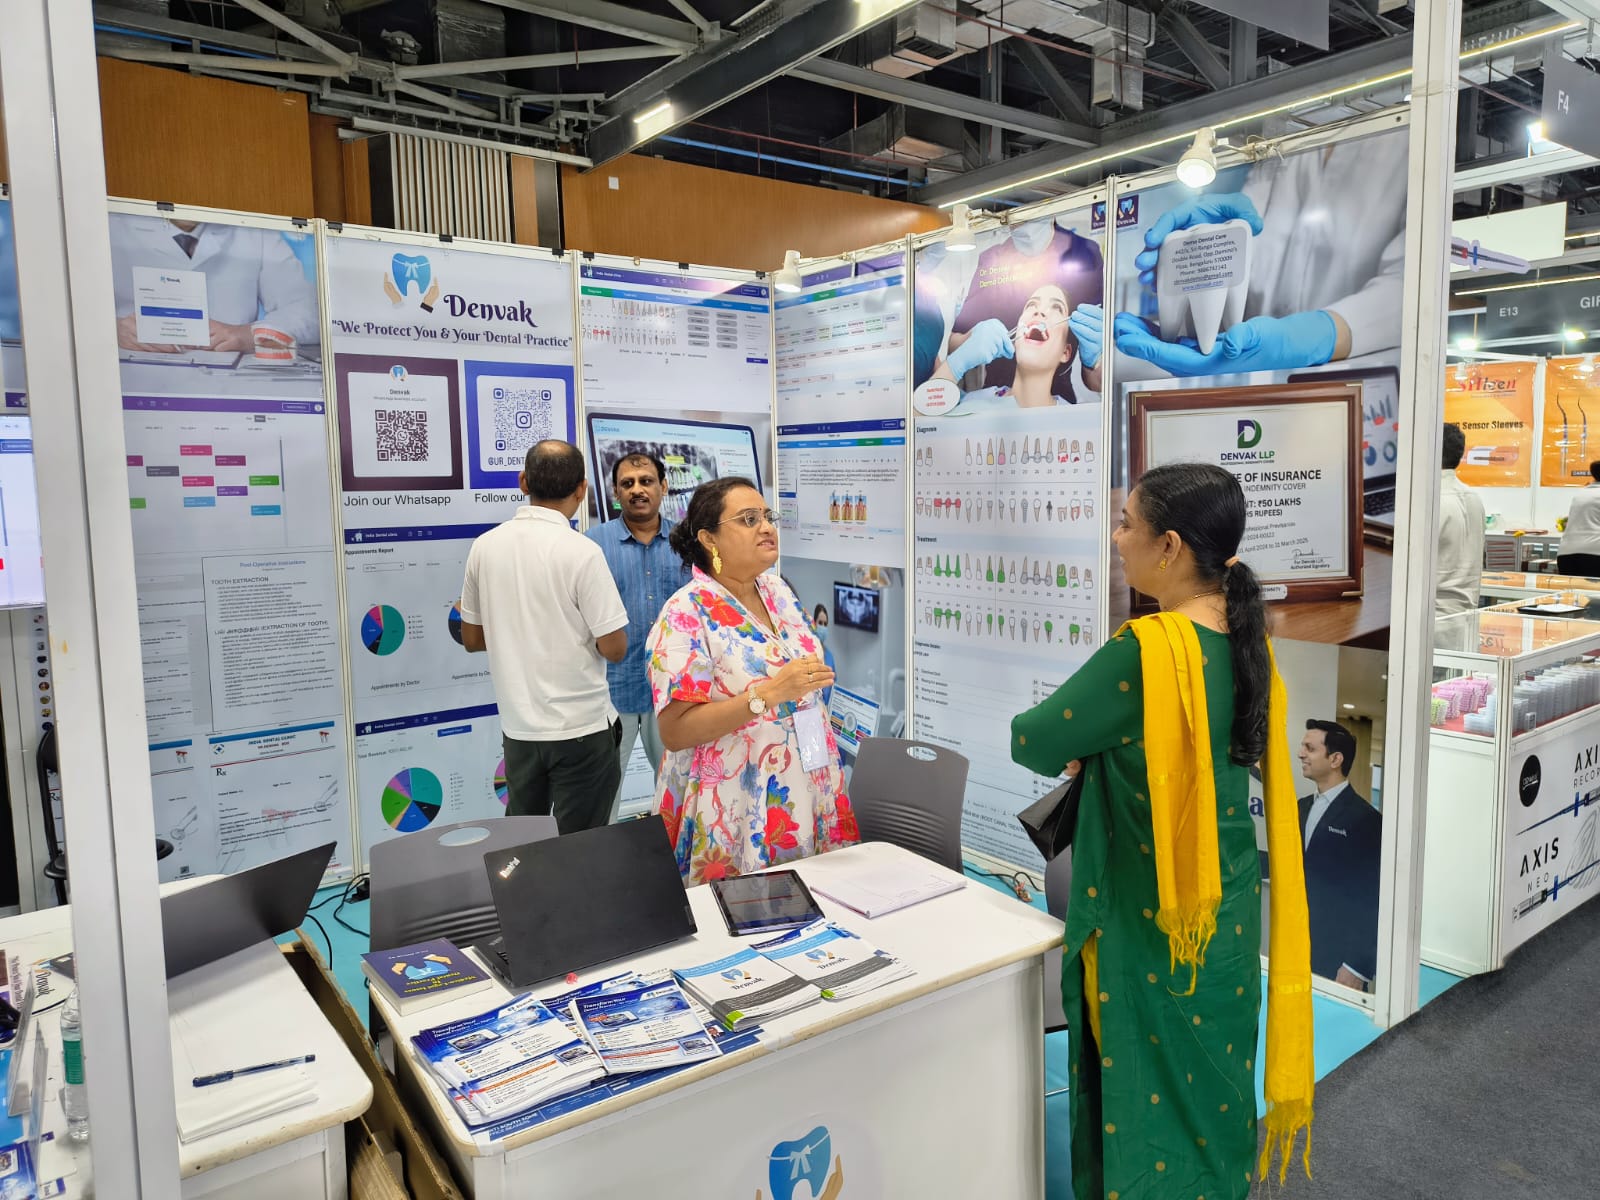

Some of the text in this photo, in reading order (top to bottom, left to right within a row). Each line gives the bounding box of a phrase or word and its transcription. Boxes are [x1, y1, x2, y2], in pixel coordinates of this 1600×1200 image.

[1557, 90, 1570, 115] F4
[443, 294, 539, 327] Denvak
[1499, 306, 1519, 317] E13
[363, 322, 411, 337] Protect
[413, 326, 437, 341] You
[440, 328, 450, 339] &
[452, 328, 481, 343] Your
[483, 331, 521, 344] Dental
[523, 334, 573, 347] Practice"
[916, 426, 937, 434] Diagnosis
[1462, 420, 1524, 430] Sensor Sleeves
[488, 456, 526, 467] @UR_DENT
[1220, 450, 1275, 461] DENVAK LLP
[1244, 472, 1258, 482] OF
[1260, 469, 1322, 482] INSURANCE
[1244, 482, 1306, 492] INDEMNITY COVER
[344, 494, 451, 507] Join our Whatsapp
[474, 493, 526, 503] Follow our
[1274, 498, 1302, 507] LAKHS
[233, 576, 269, 584] EXTRACTION
[1574, 744, 1600, 773] AXI
[1520, 837, 1559, 877] AXIS
[1527, 872, 1549, 893] NEO
[732, 977, 765, 991] Denvak
